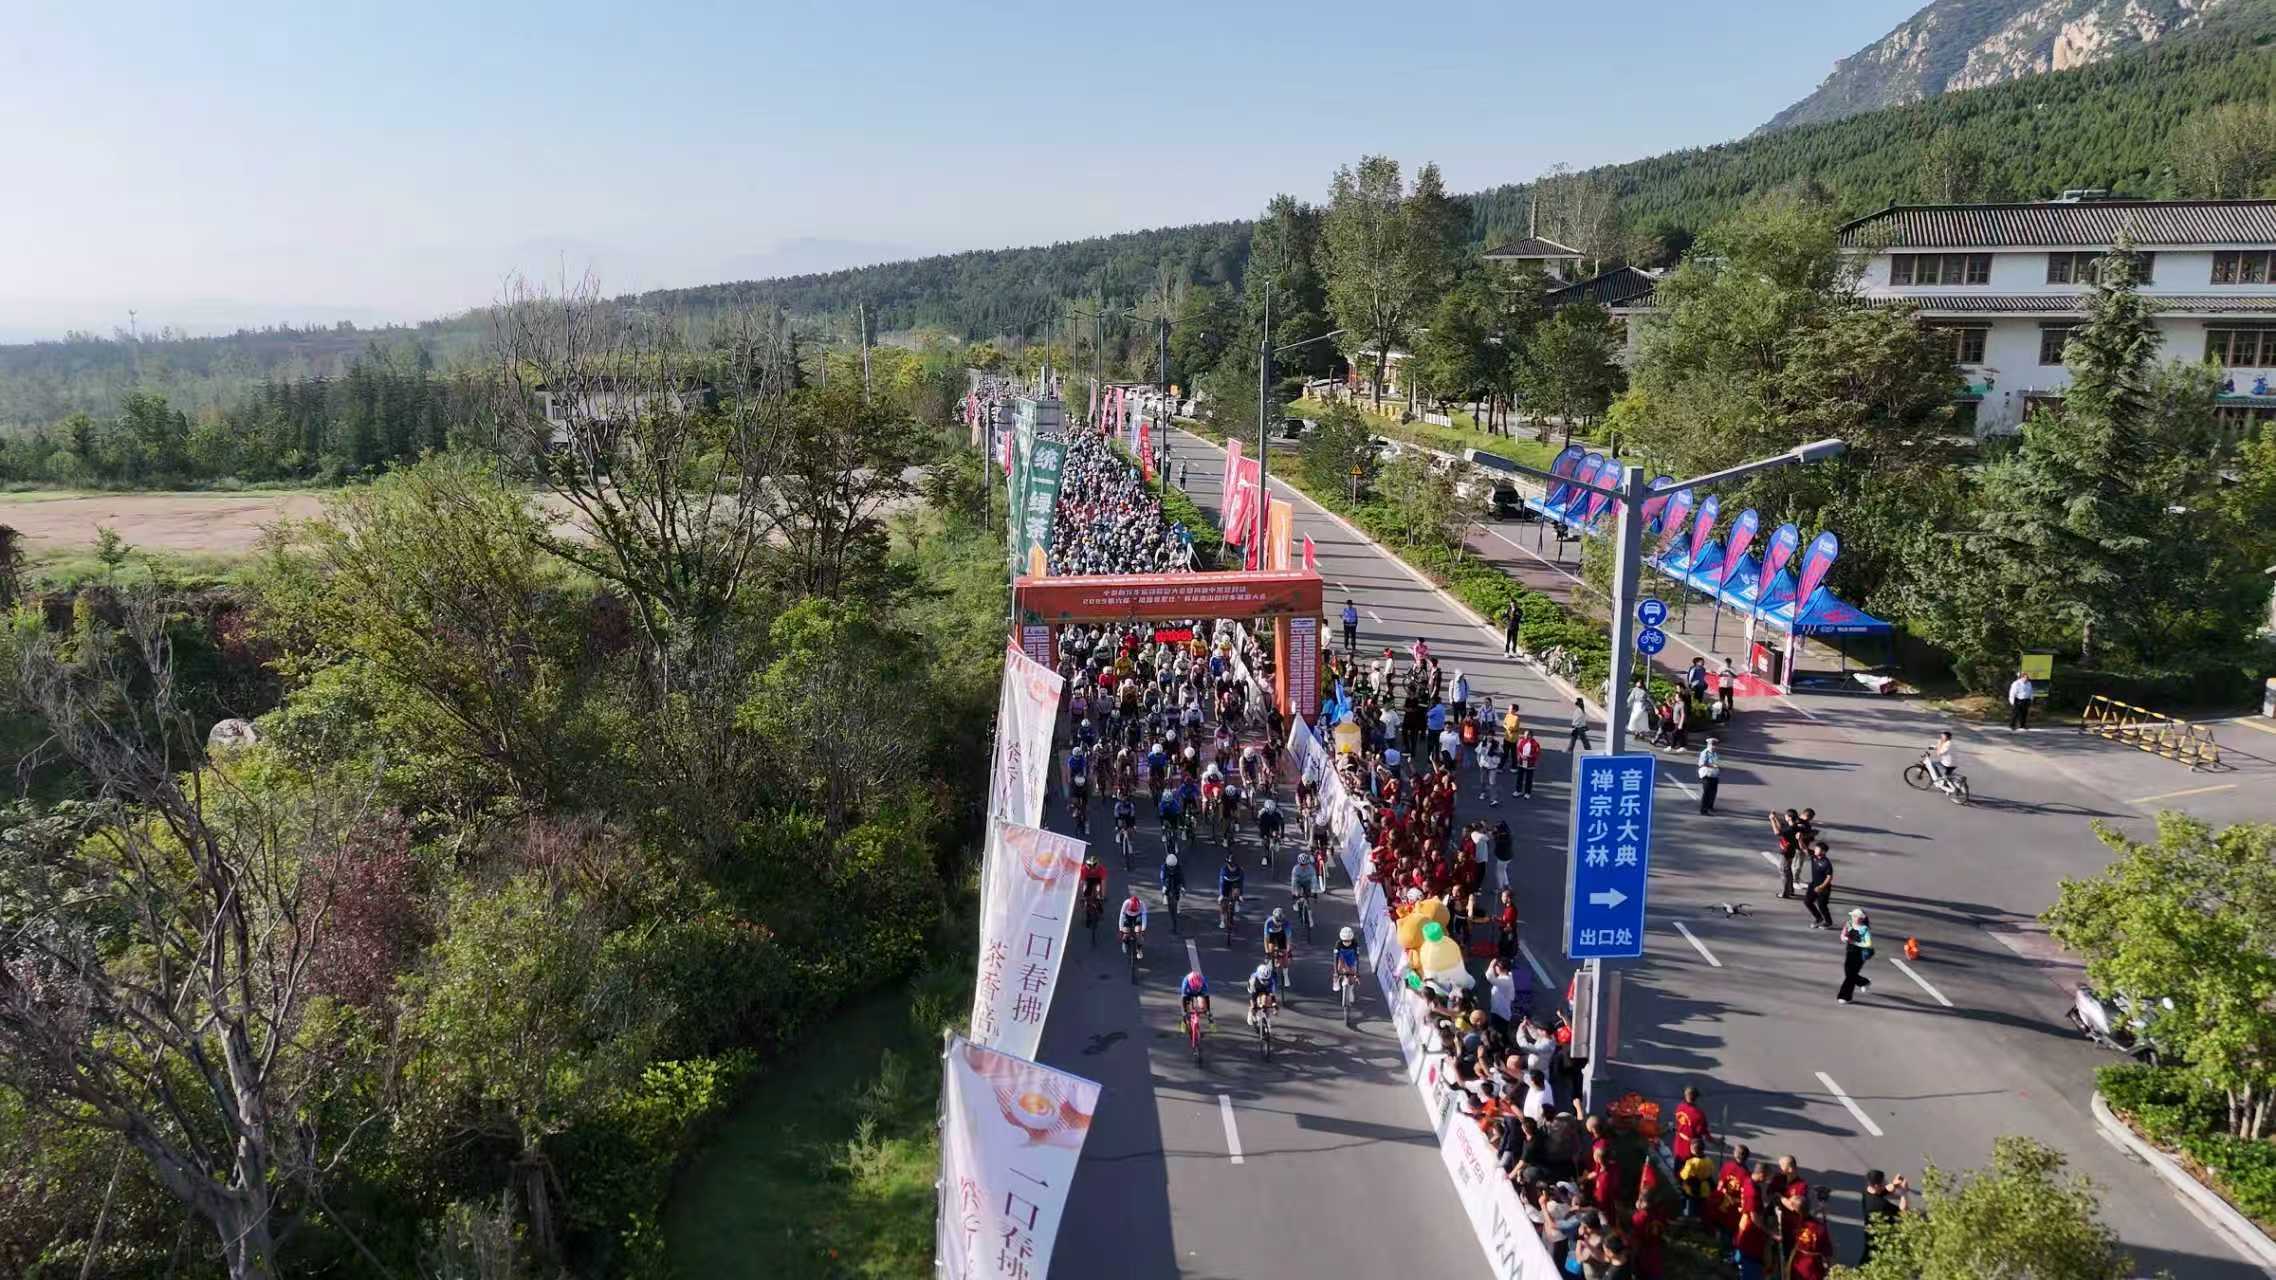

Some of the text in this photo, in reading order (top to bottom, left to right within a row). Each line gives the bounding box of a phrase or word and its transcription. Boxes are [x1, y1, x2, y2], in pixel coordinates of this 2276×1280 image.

[1026, 446, 1060, 540] 统一绿茶
[1585, 769, 1614, 867] 禅宗少林
[1615, 768, 1643, 867] 音乐大典
[1012, 912, 1059, 1025] 一口春拂
[1579, 928, 1633, 945] 出口处
